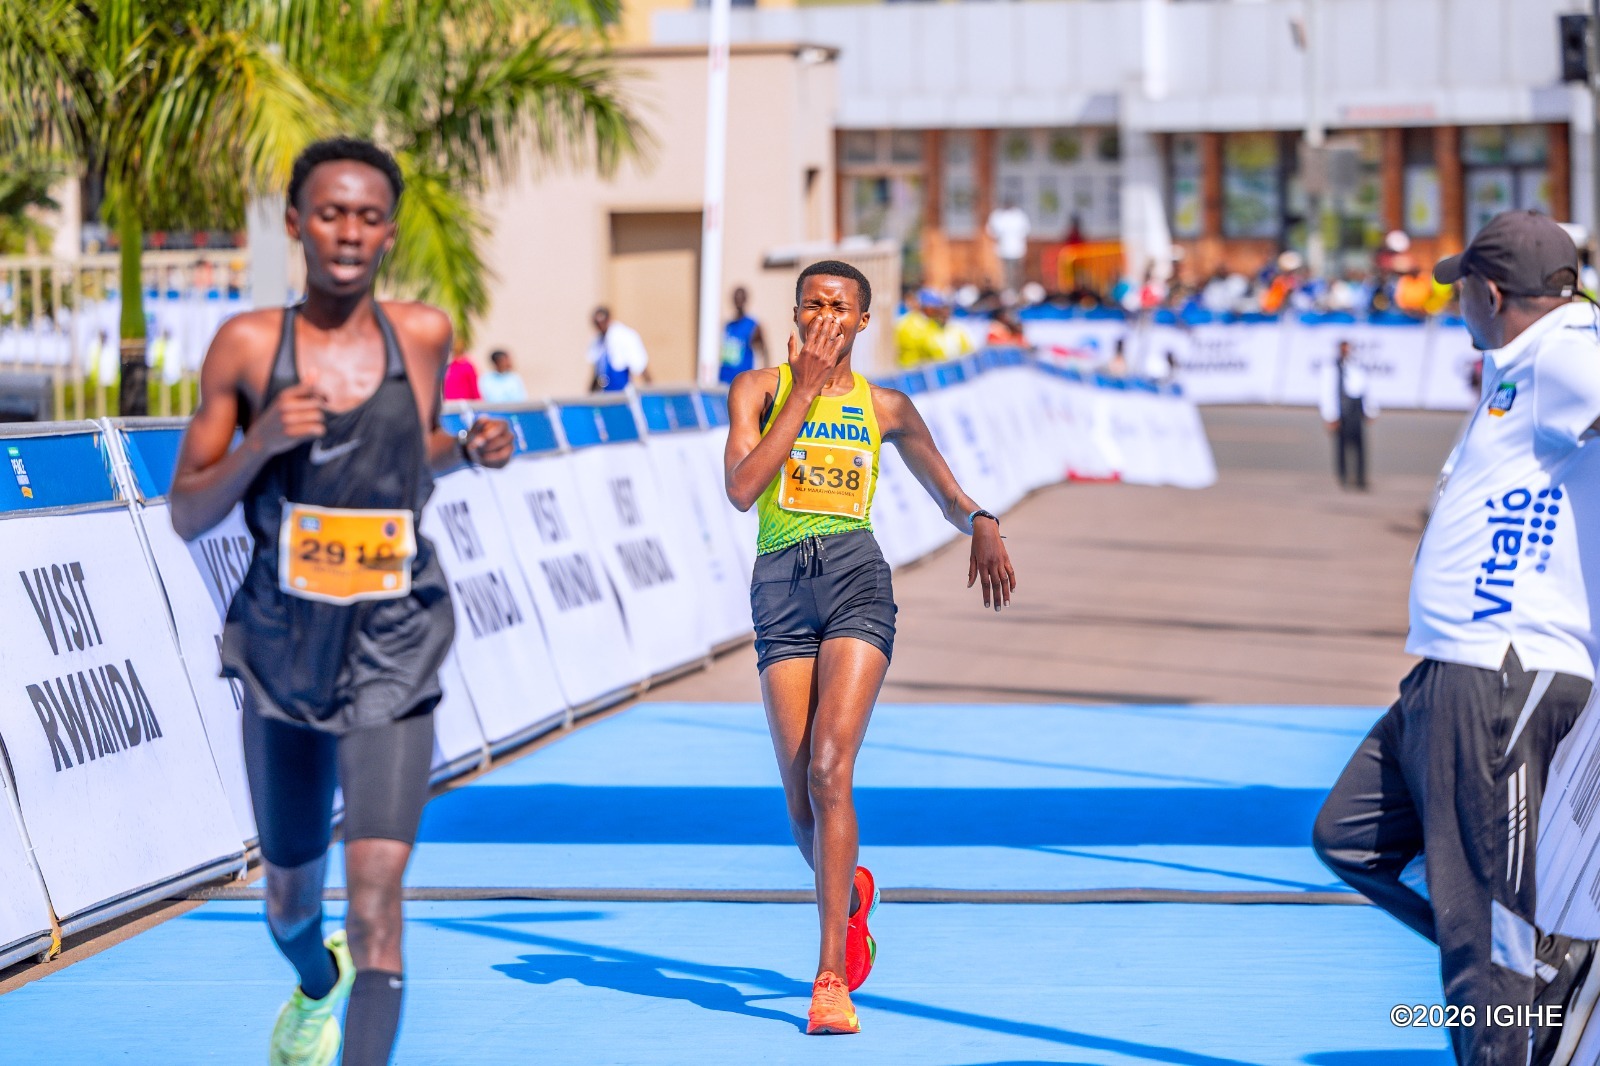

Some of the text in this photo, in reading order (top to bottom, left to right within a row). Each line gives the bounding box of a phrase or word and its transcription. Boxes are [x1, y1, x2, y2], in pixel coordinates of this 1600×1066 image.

[797, 421, 871, 445] WANDA
[791, 465, 860, 490] 4538
[437, 500, 485, 563] VISIT
[19, 561, 103, 656] VISIT
[455, 567, 523, 639] RWANDA
[25, 659, 163, 773] RWANDA
